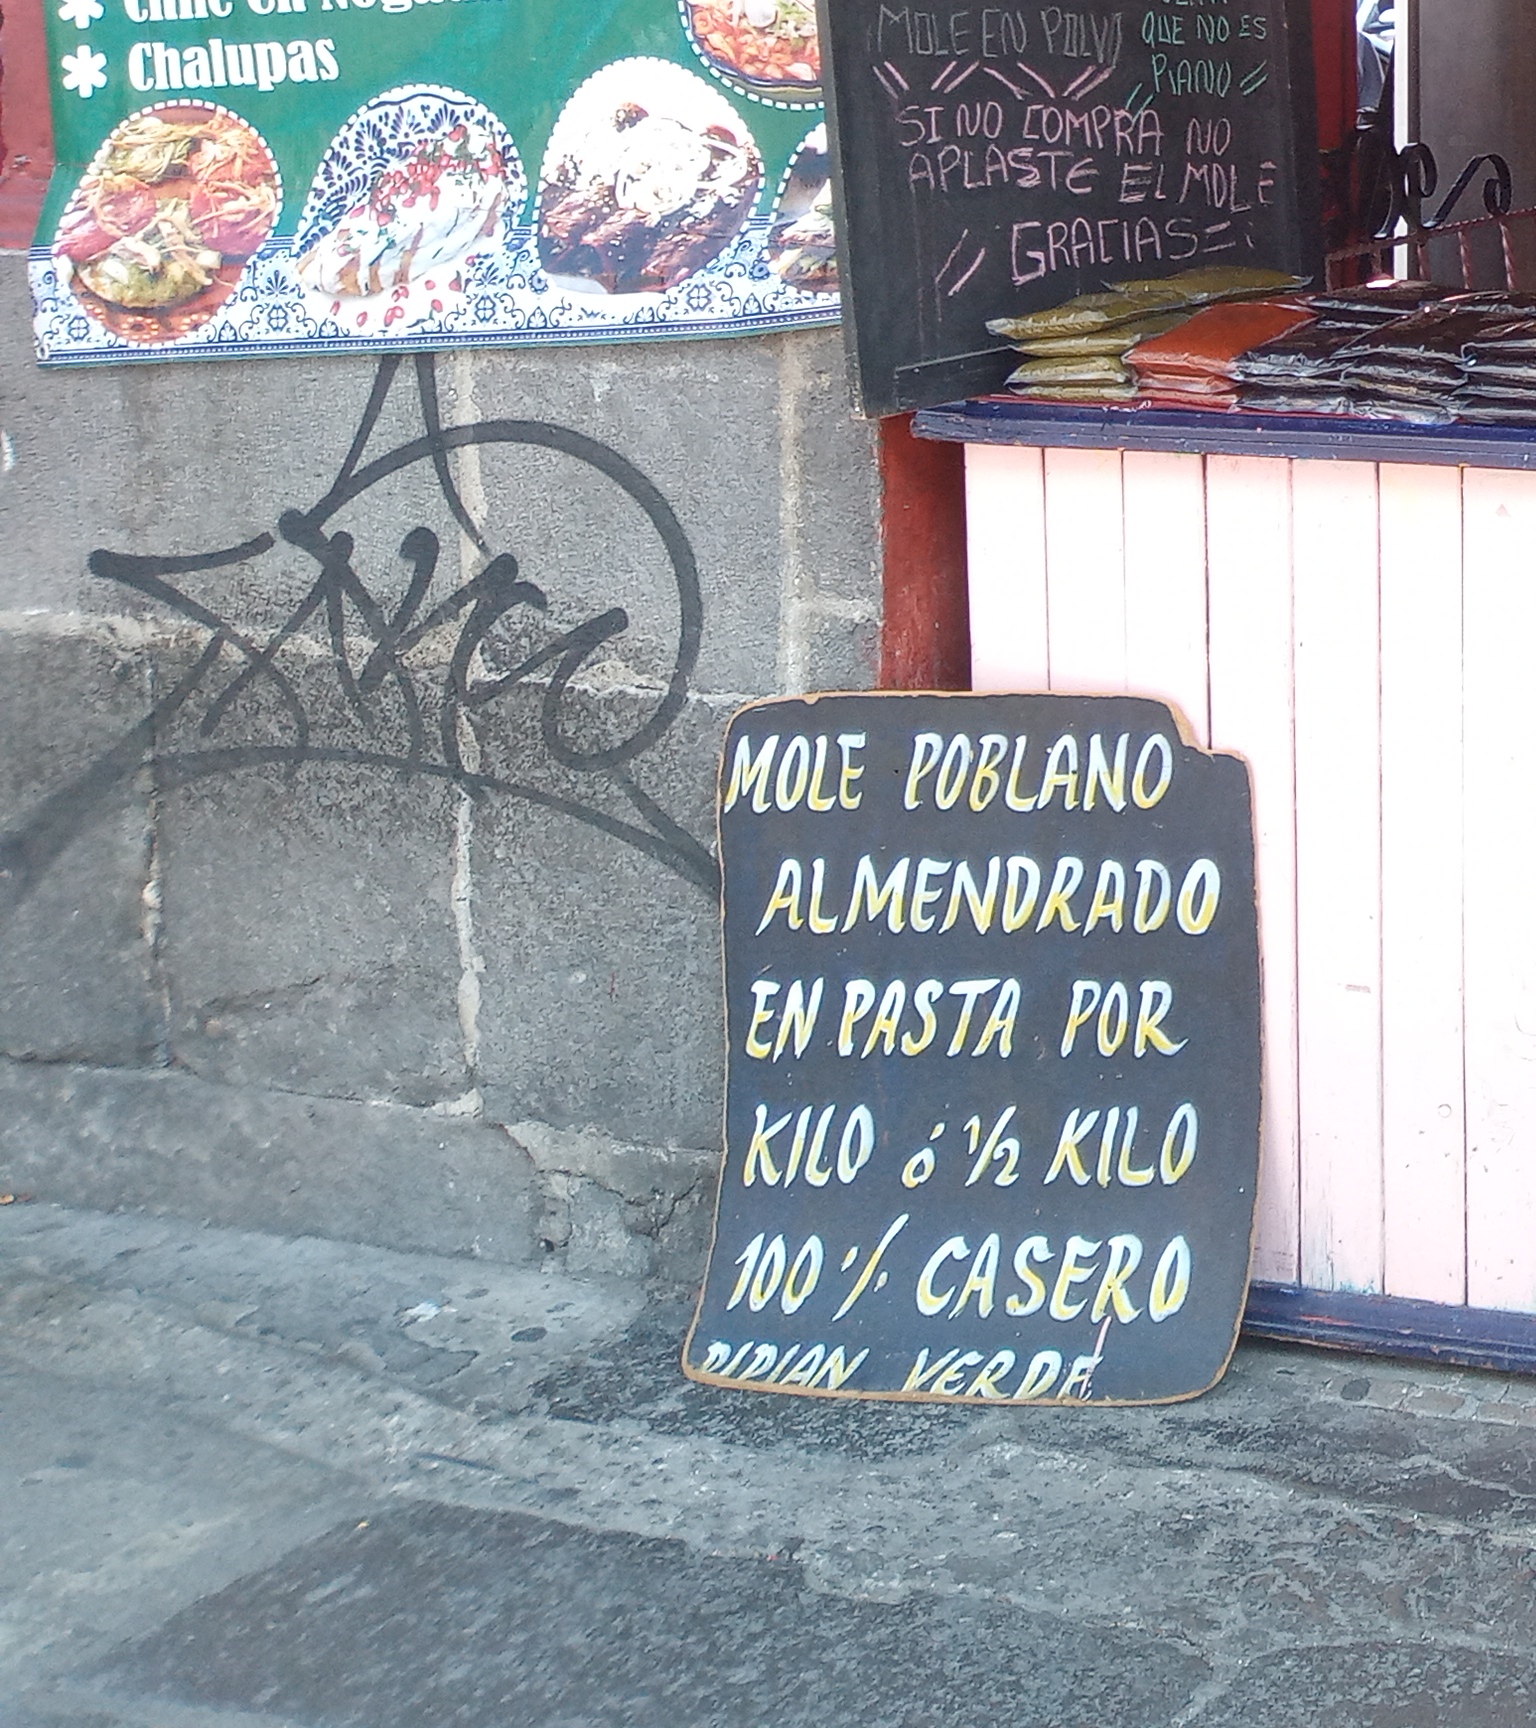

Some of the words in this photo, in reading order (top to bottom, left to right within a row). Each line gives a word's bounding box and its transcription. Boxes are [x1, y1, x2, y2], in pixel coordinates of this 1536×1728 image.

[877, 3, 970, 55] MOLE
[982, 9, 1029, 58] EN
[1142, 11, 1184, 48] QUE
[1197, 15, 1231, 43] NO
[1239, 15, 1267, 40] ES
[127, 36, 340, 93] Chalupas
[1152, 53, 1232, 98] PIANO
[898, 104, 945, 147] SI
[956, 101, 1002, 140] NO
[1023, 103, 1164, 157] COMPRA
[1186, 117, 1232, 157] NO
[908, 144, 1100, 195] APLASTE
[1119, 161, 1167, 204] EL
[1178, 160, 1278, 212] MOLE
[1010, 216, 1199, 287] GRACIAS
[724, 731, 867, 814] MOLE
[904, 732, 1173, 812] POBLANO
[755, 855, 1222, 936] ALMENDRADO
[744, 977, 824, 1062] EN
[836, 977, 1022, 1060] PASTA
[1060, 979, 1189, 1059] POR
[742, 1103, 875, 1187] KILO
[1043, 1103, 1200, 1187] KILO
[915, 1232, 1193, 1324] CASERO
[701, 1340, 871, 1390] PIPIAN
[902, 1346, 1104, 1401] VERDE
